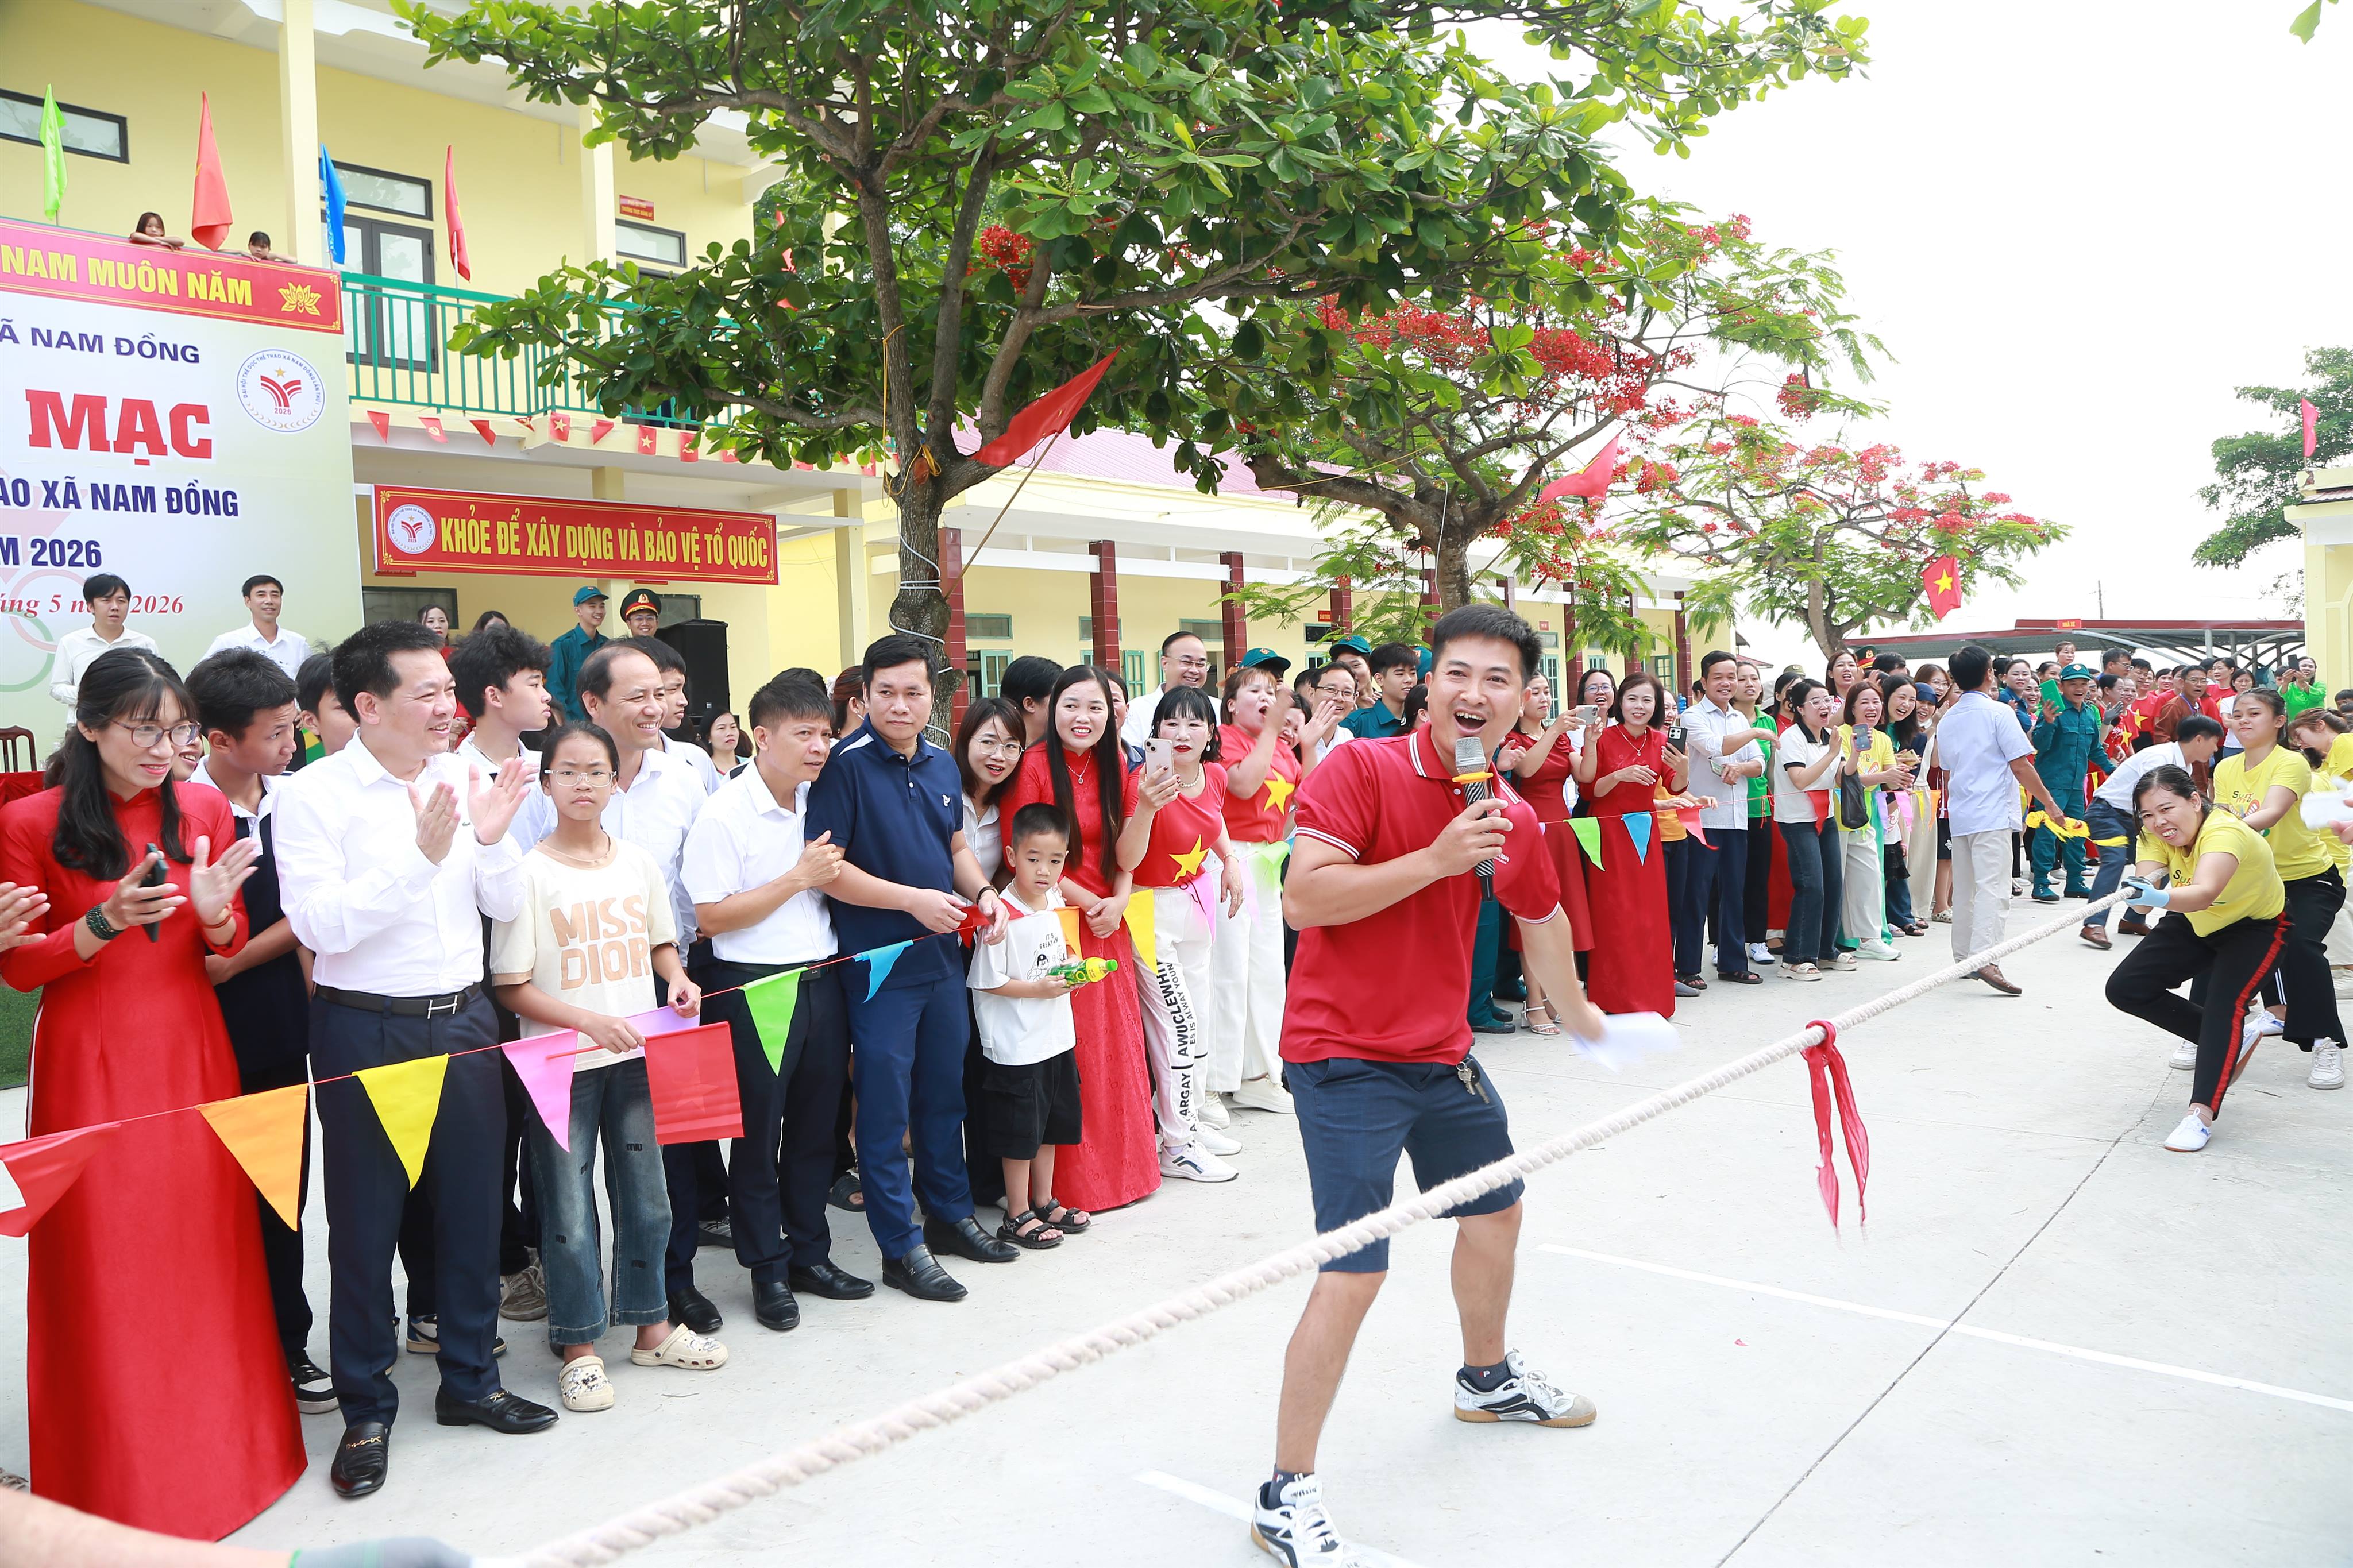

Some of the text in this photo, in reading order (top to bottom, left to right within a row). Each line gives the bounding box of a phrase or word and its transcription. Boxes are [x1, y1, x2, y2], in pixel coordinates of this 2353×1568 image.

[1, 245, 253, 306] NAM MUÔN NĂM
[30, 327, 104, 353] NAM
[114, 332, 200, 364] ĐỒNG
[25, 389, 213, 466] MẠC
[41, 476, 82, 510] XÃ
[90, 483, 157, 513] NAM
[165, 479, 239, 517] ĐỒNG
[30, 538, 102, 568] 2026
[441, 504, 492, 555] KHỎE
[496, 508, 520, 555] ĐỂ
[526, 516, 561, 557] XÂY
[565, 523, 614, 566] DỰNG
[618, 522, 641, 561] VÀ
[644, 516, 677, 563] BẢO
[681, 526, 701, 571] VỆ
[704, 522, 724, 566] TỔ
[728, 526, 768, 570] QUỐC
[49, 594, 62, 613] 5
[130, 594, 184, 614] 2026
[549, 895, 647, 948] MISS
[561, 937, 651, 990] DIOR
